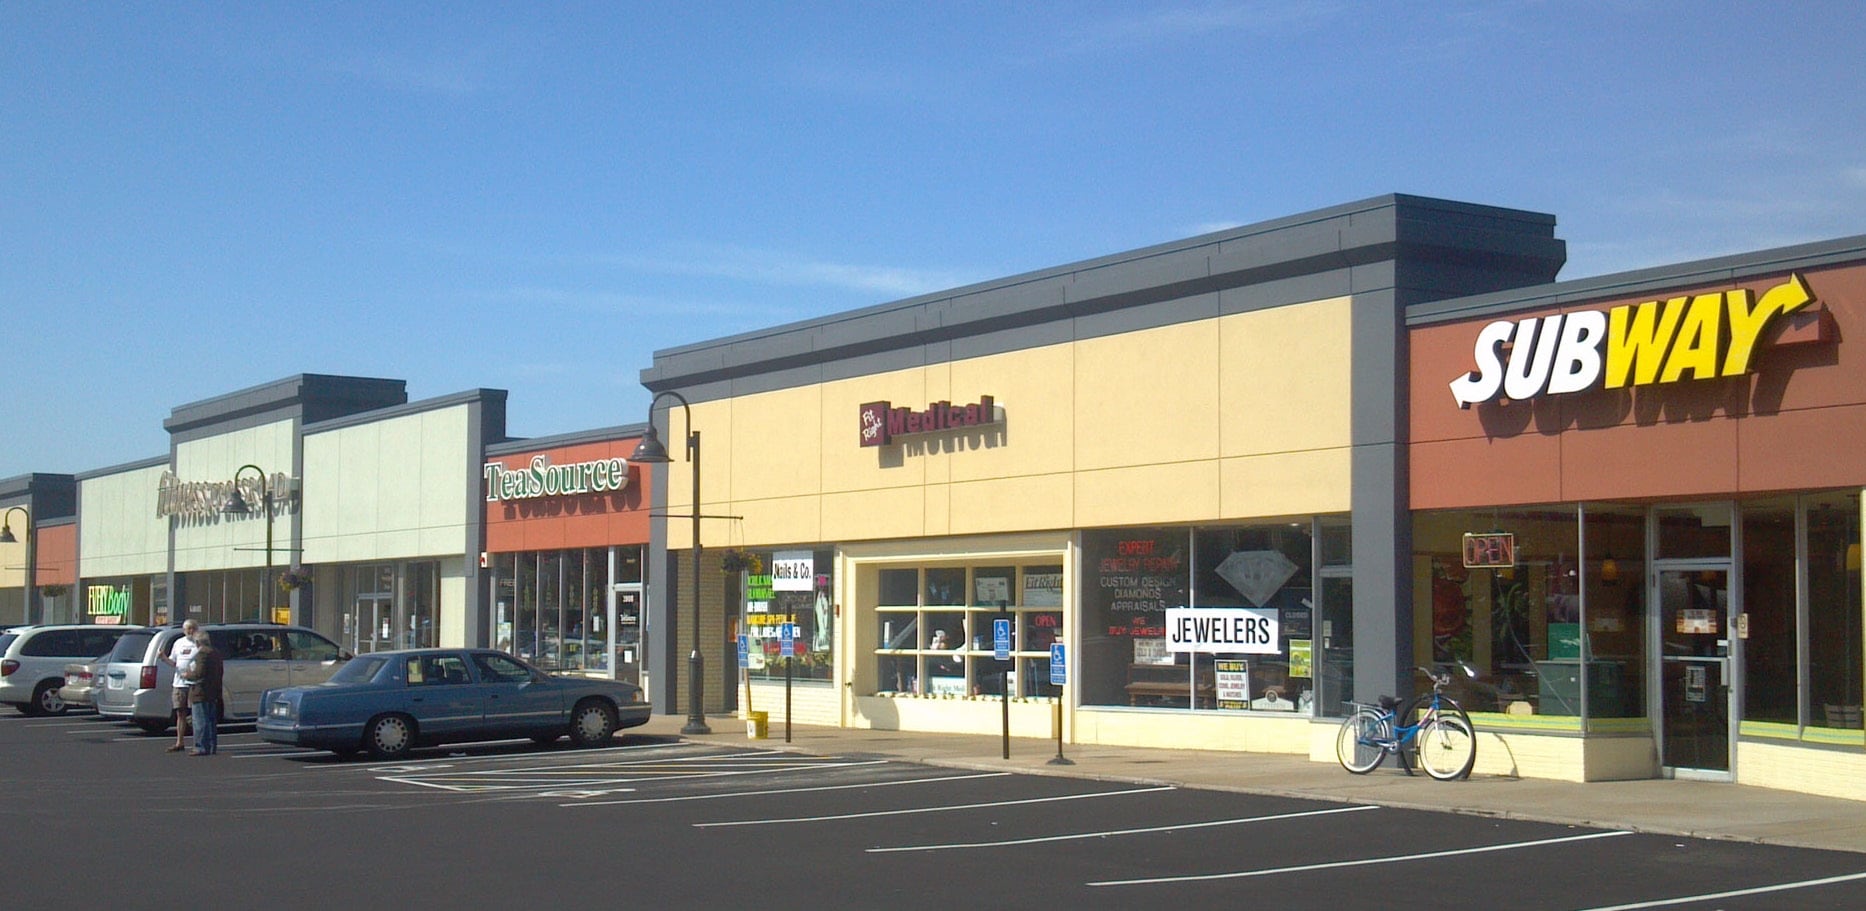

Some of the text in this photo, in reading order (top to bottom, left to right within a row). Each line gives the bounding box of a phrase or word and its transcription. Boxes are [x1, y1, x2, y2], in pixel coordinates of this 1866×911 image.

[1448, 272, 1816, 409] SUBWAY
[862, 409, 875, 427] Fit
[887, 395, 994, 435] Medical
[862, 418, 883, 442] Right
[484, 455, 629, 501] TeaSource
[1118, 540, 1156, 555] EXPERT
[1466, 536, 1512, 564] OPEN
[773, 562, 812, 580] Nails & Co.
[1100, 575, 1176, 588] CUSTOM DESIGN
[1114, 587, 1162, 600] DIAMONDS
[1111, 600, 1166, 612] APPRAISALS
[1035, 615, 1057, 627] OPEN
[1172, 616, 1270, 645] JEWELERS
